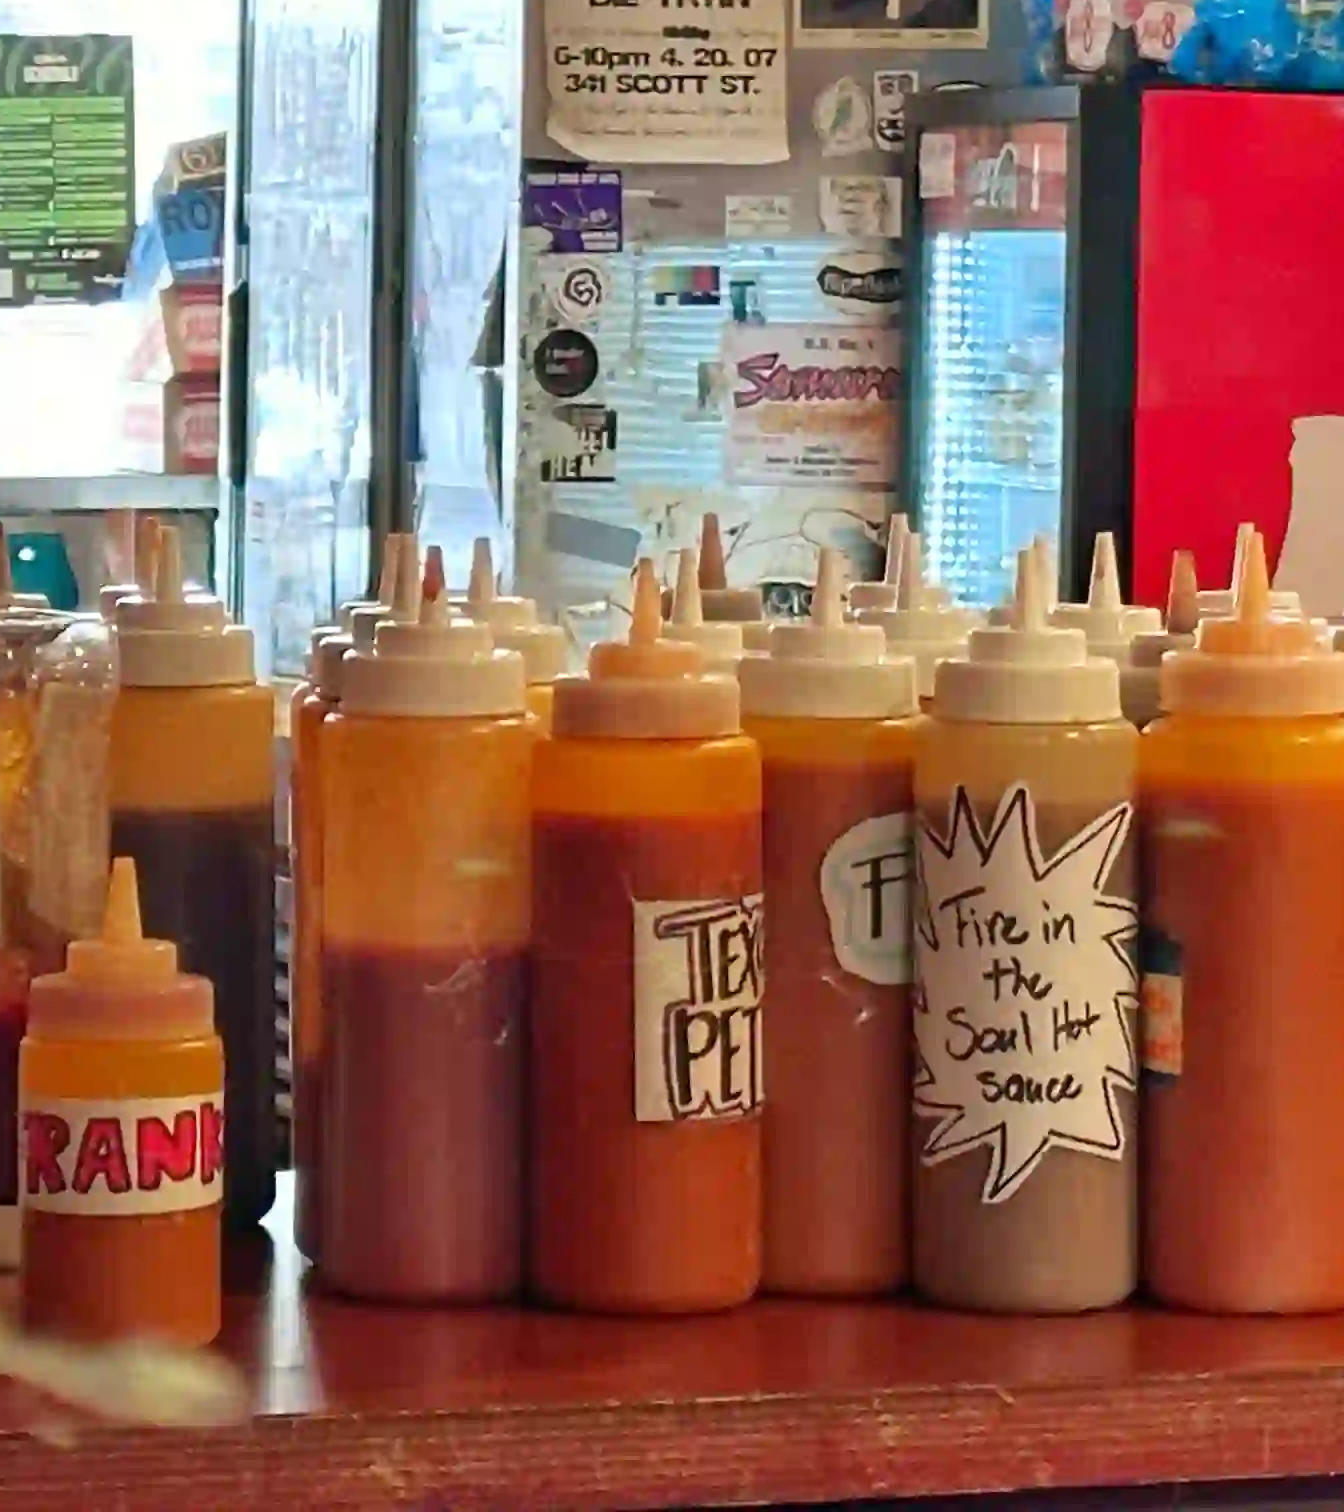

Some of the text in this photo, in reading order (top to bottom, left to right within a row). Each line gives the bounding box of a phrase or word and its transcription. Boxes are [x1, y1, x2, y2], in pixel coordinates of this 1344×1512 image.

[554, 46, 650, 70] 6-10pm
[744, 48, 778, 67] 07
[616, 75, 708, 94] SCOTT
[719, 75, 760, 94] ST.
[940, 886, 1076, 949] Fire in
[983, 958, 1053, 1001] the
[945, 1000, 1102, 1064] Soul Hot
